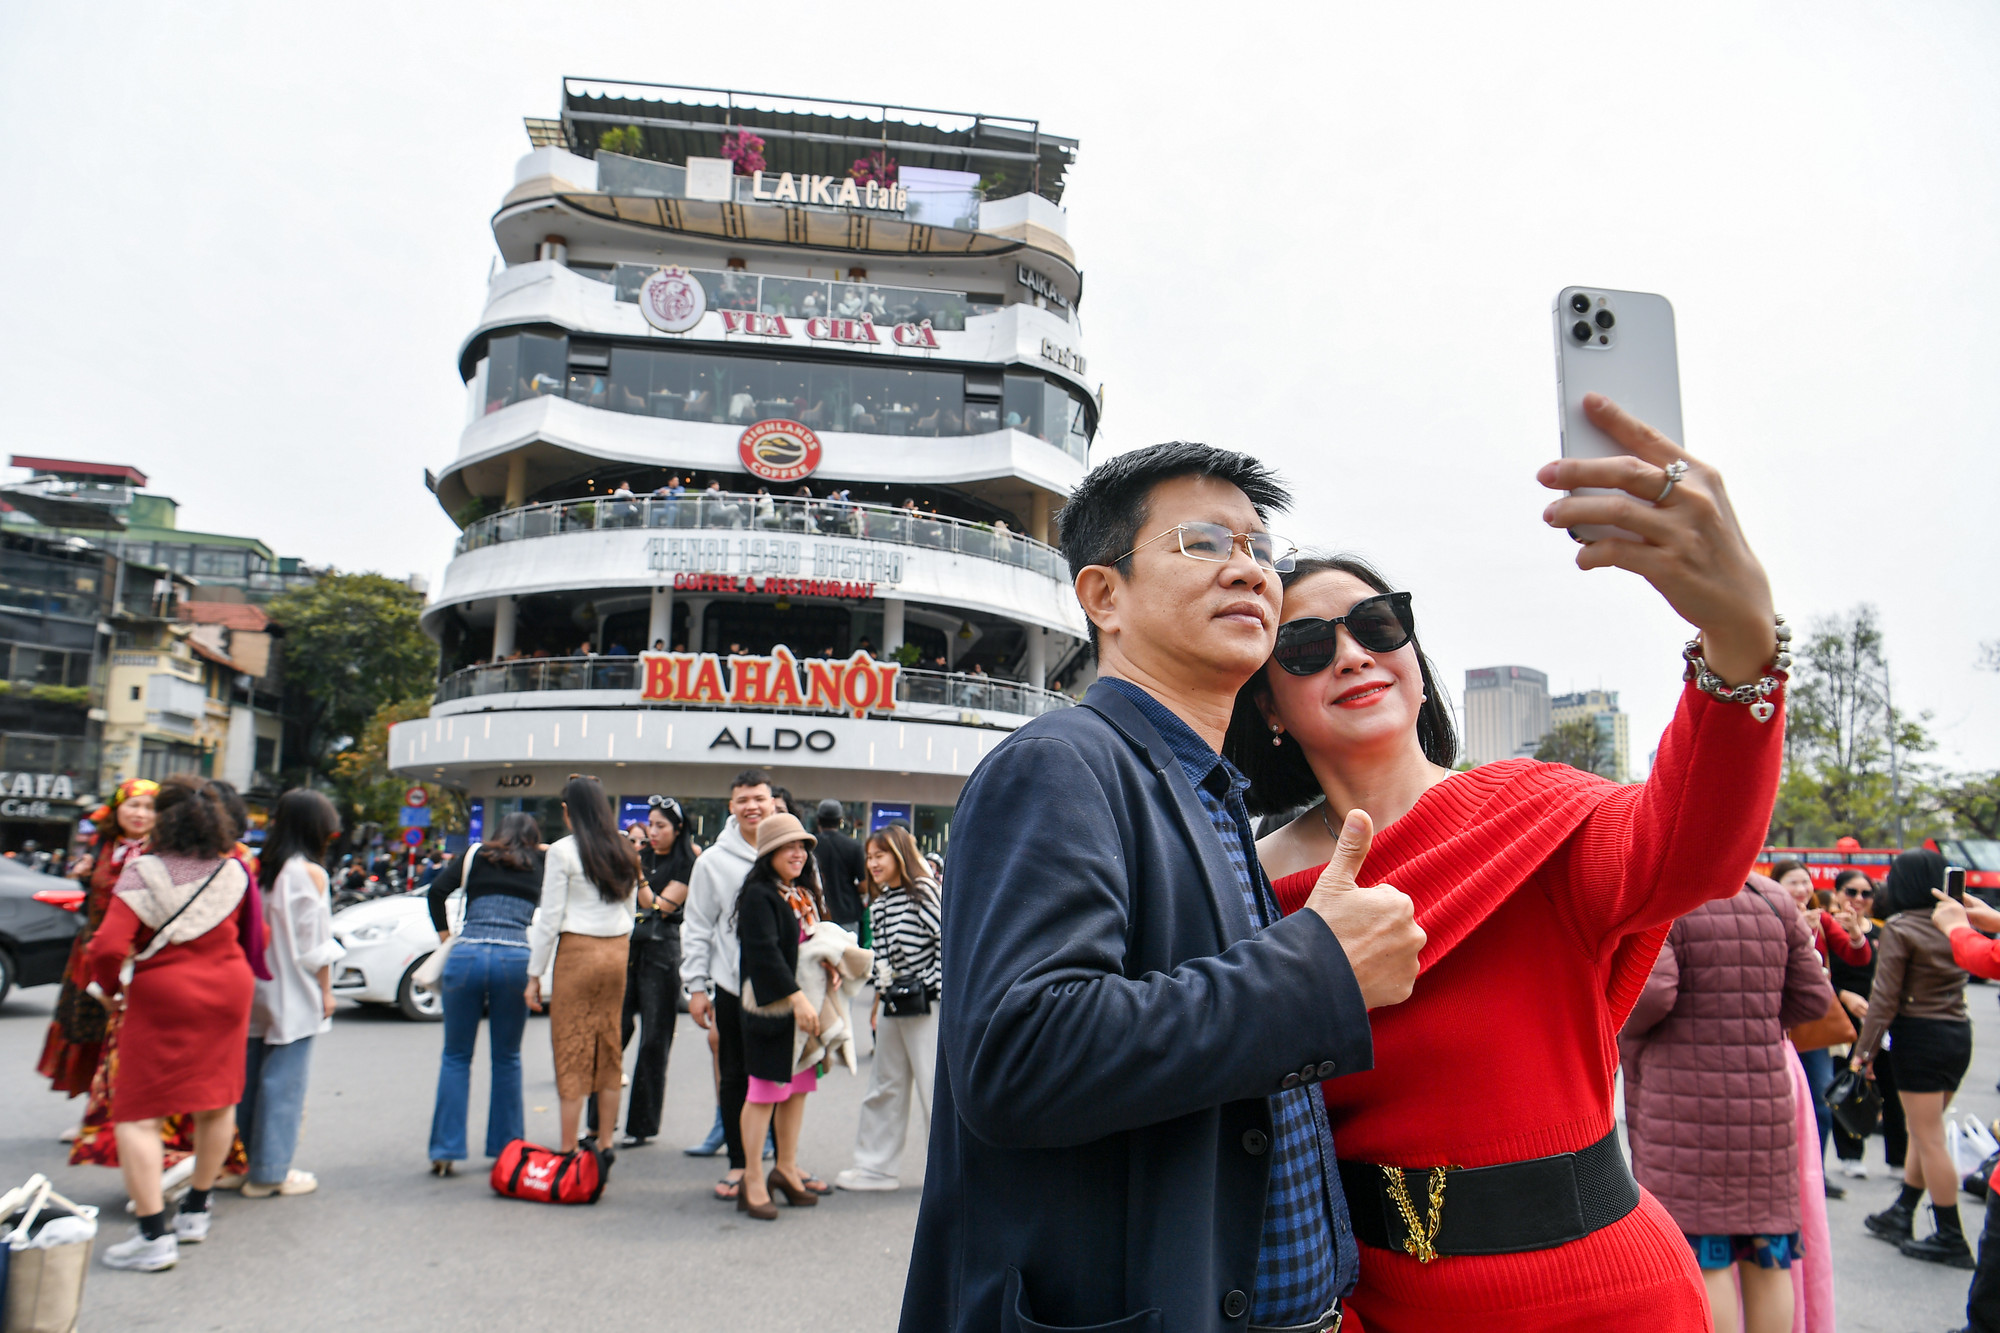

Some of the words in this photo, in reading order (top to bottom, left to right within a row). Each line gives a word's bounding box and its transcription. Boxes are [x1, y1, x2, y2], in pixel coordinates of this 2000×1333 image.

[753, 170, 861, 207] LAIKA
[1018, 263, 1058, 303] LAIKA
[717, 309, 792, 338] VUA
[805, 312, 881, 345] CHẢ
[743, 422, 818, 450] HIGHLANDS
[751, 461, 809, 478] COFFEE
[648, 537, 729, 571] HANOI
[738, 538, 801, 574] 1930
[813, 543, 904, 583] BISTRO
[674, 572, 739, 593] COFFEE
[744, 576, 758, 593] &
[764, 576, 877, 599] RESTAURANT
[641, 655, 726, 702] BIA
[730, 648, 804, 706] HÀ
[806, 653, 900, 719] NỘI
[709, 727, 836, 753] ALDO
[497, 774, 534, 788] ALDO
